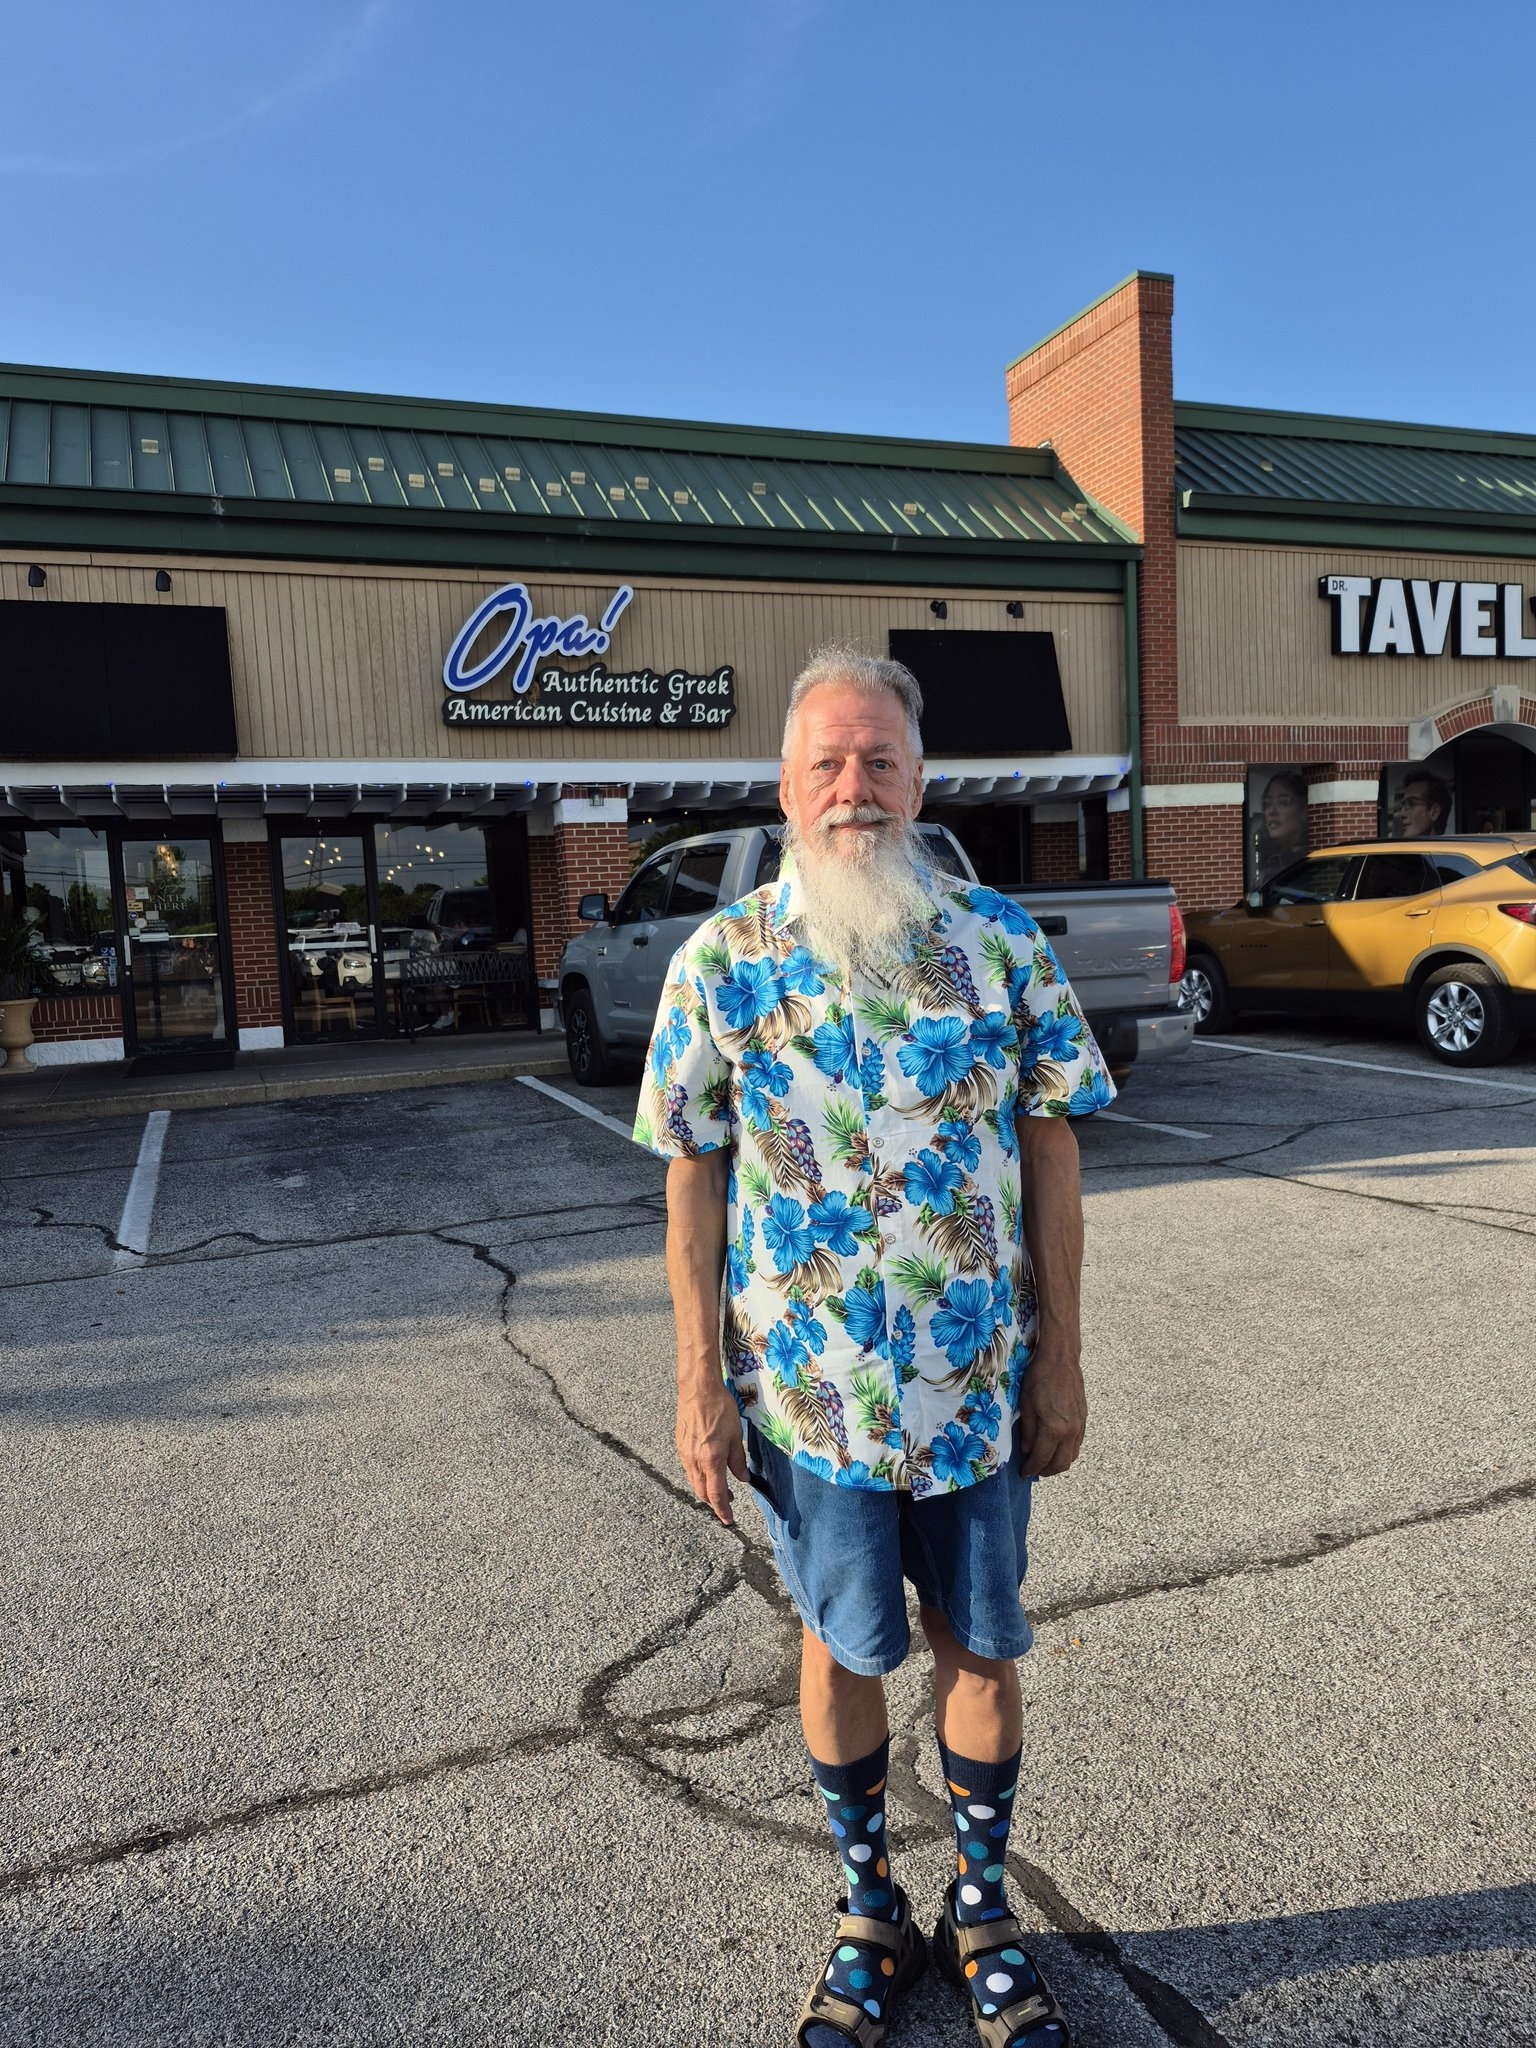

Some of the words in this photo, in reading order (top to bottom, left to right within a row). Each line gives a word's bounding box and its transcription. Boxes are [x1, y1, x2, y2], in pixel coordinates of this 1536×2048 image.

[1332, 580, 1348, 592] DR.
[1326, 575, 1536, 657] TAVEL
[444, 583, 633, 693] Opa!
[542, 667, 658, 694] Authentic
[668, 668, 730, 700] Greek
[447, 699, 562, 722] American
[570, 700, 652, 723] Cuisine
[660, 707, 682, 723] &
[689, 703, 731, 724] Bar
[154, 902, 187, 911] HERE
[1077, 954, 1165, 971] TUNDRA
